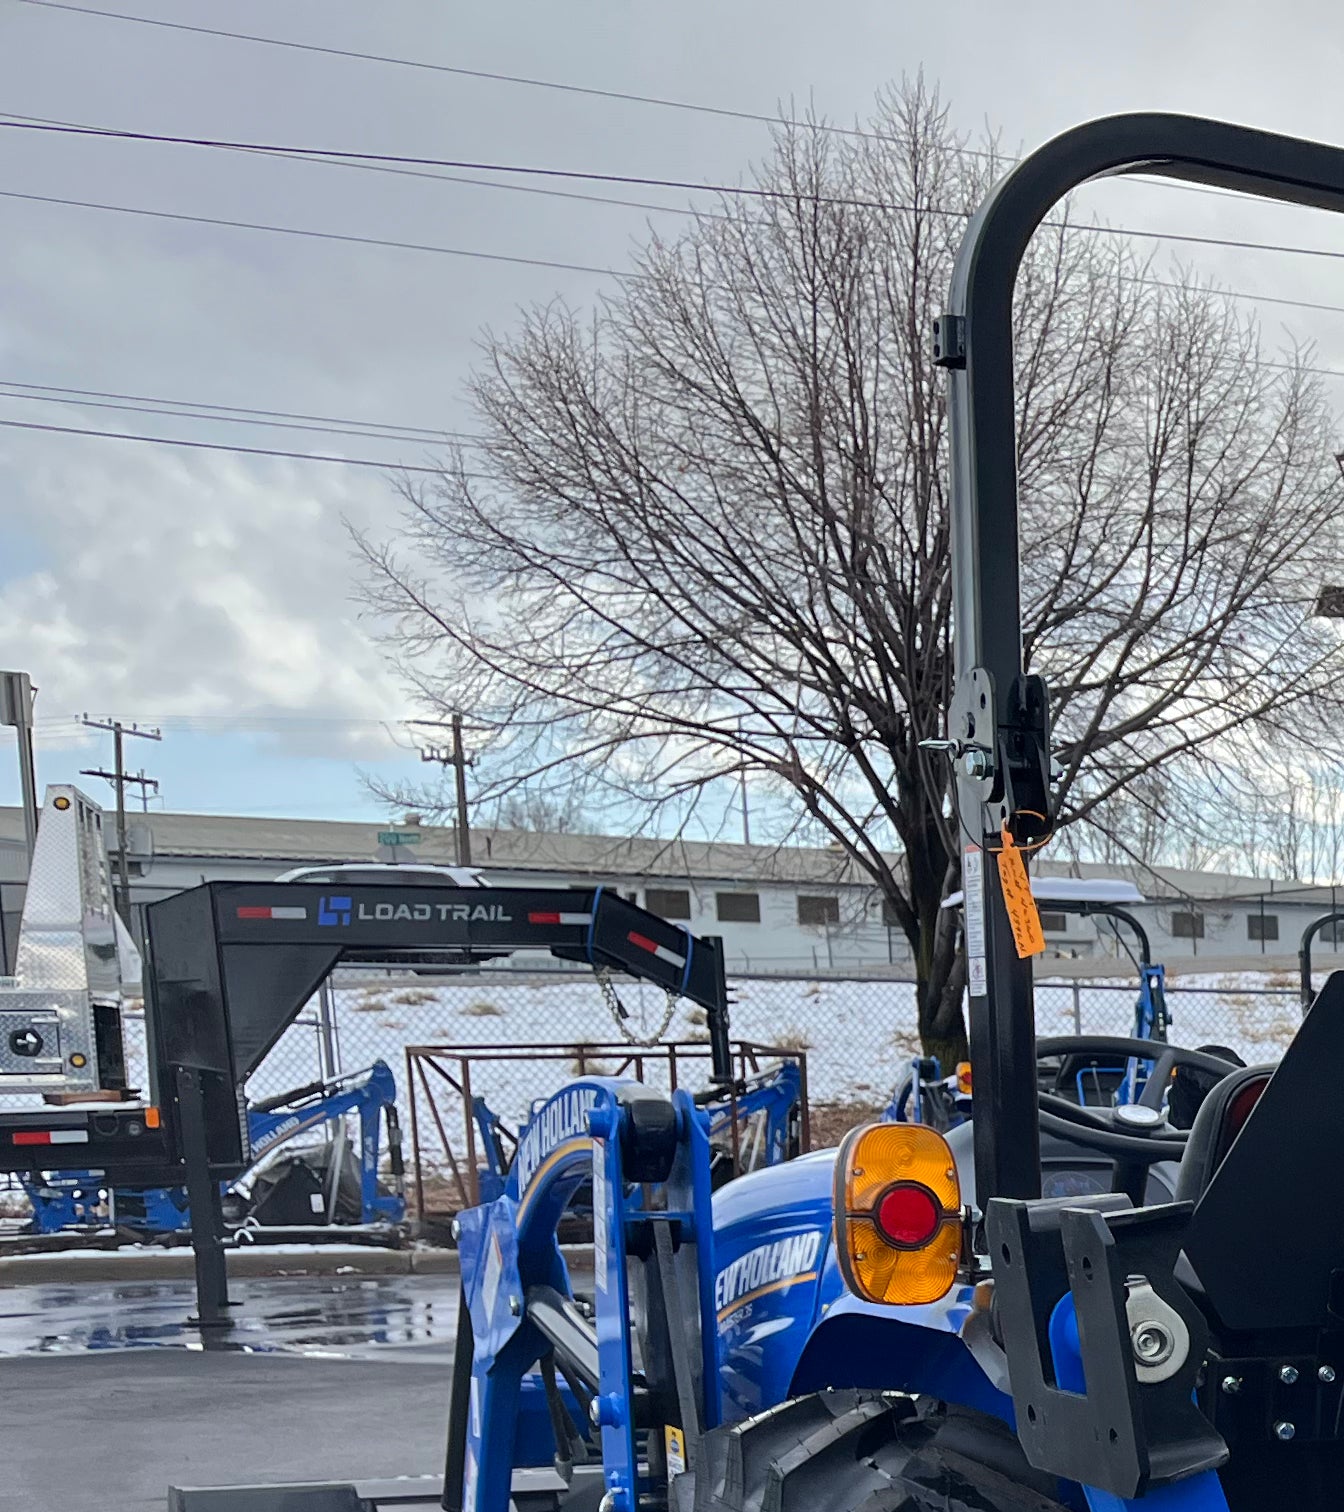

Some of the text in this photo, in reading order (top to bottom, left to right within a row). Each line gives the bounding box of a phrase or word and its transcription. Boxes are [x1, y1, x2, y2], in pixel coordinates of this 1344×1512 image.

[358, 903, 512, 922] LOAD TRAIL
[518, 1089, 598, 1201] NEW HOLLAN
[737, 1231, 821, 1296] HOLLAND
